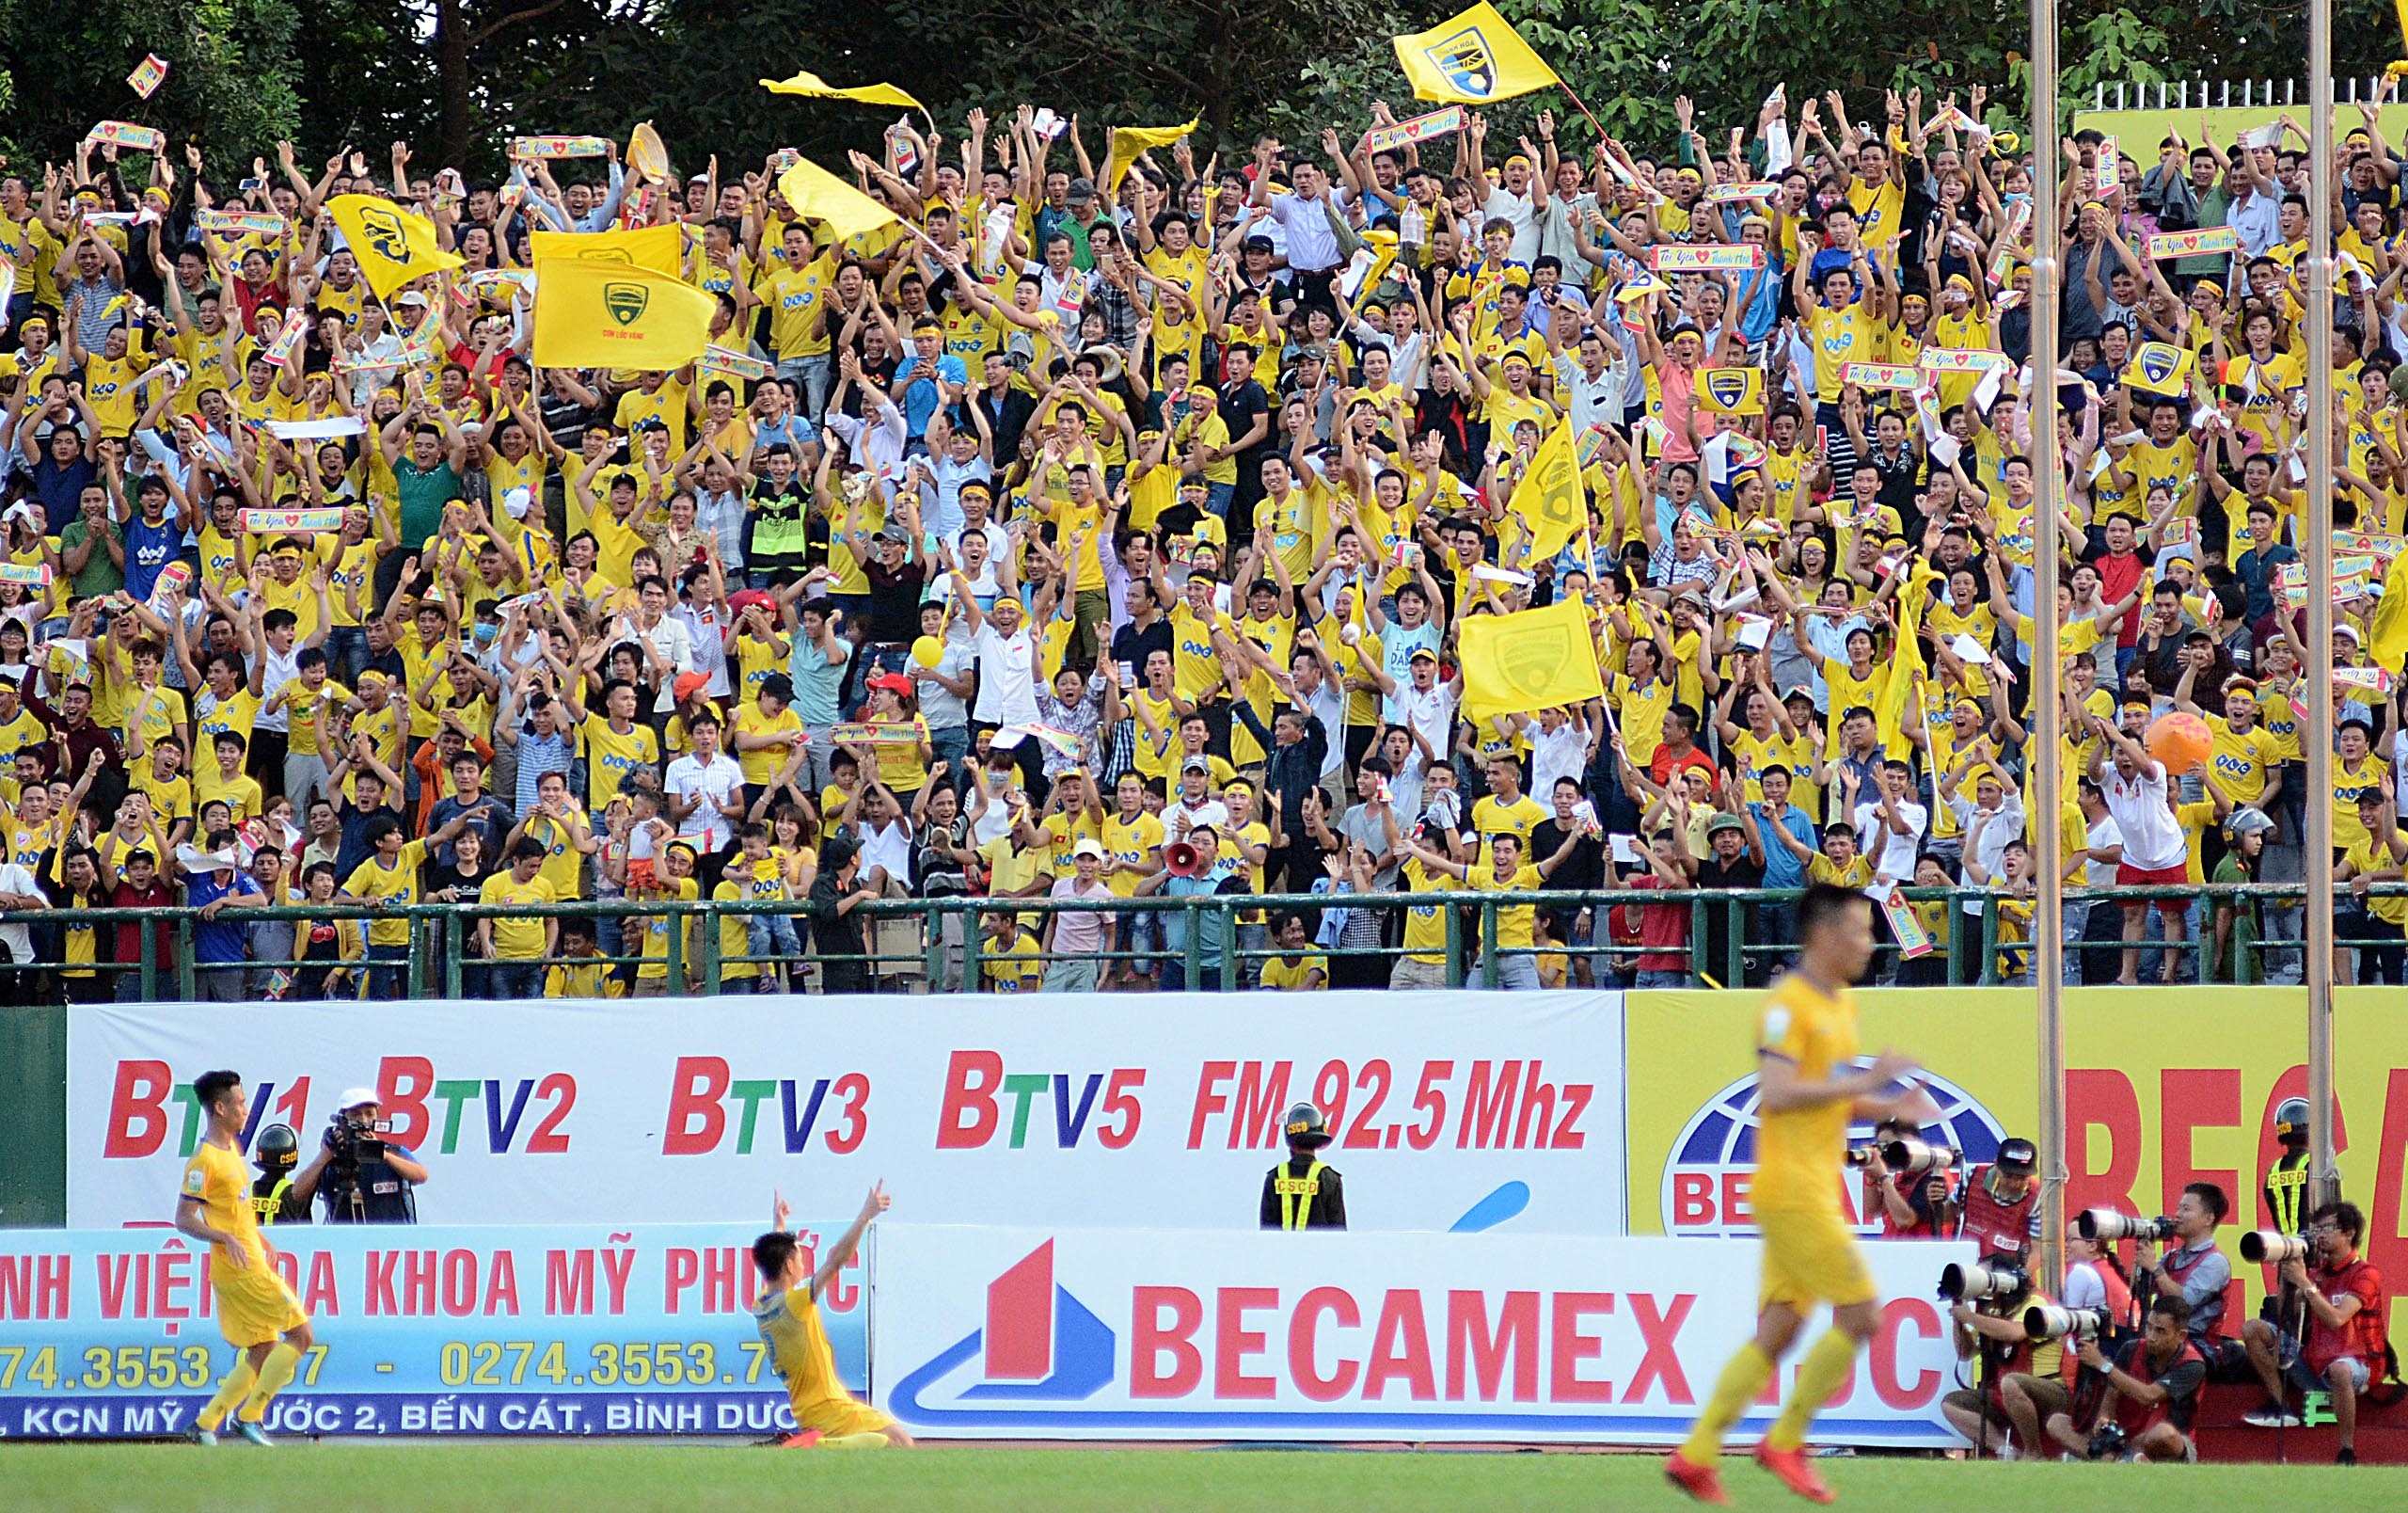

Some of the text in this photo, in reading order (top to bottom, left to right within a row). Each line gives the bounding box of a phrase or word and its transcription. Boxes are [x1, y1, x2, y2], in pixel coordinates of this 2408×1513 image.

[783, 292, 814, 308] FLC
[1182, 640, 1212, 658] FLC
[2269, 721, 2295, 735] FLC
[602, 753, 637, 770] FLC
[2215, 754, 2252, 775] FLC
[2216, 769, 2244, 783] GROUP
[752, 878, 780, 894] FLC
[374, 1056, 577, 1154] BTV2
[661, 1056, 869, 1155] BTV3
[936, 1050, 1147, 1150] BTV5
[1186, 1060, 1293, 1150] FM
[1312, 1059, 1454, 1150] 92.5
[1456, 1059, 1593, 1150] Mhz
[364, 1249, 520, 1317] KHOA
[545, 1232, 637, 1315] MỸ
[1130, 1285, 1696, 1407] BECAMEX
[24, 1408, 109, 1434] KCN
[123, 1401, 183, 1433] MỸ
[401, 1395, 485, 1430] BẾN
[499, 1397, 592, 1434] CÁT,
[606, 1398, 703, 1430] BÌNH
